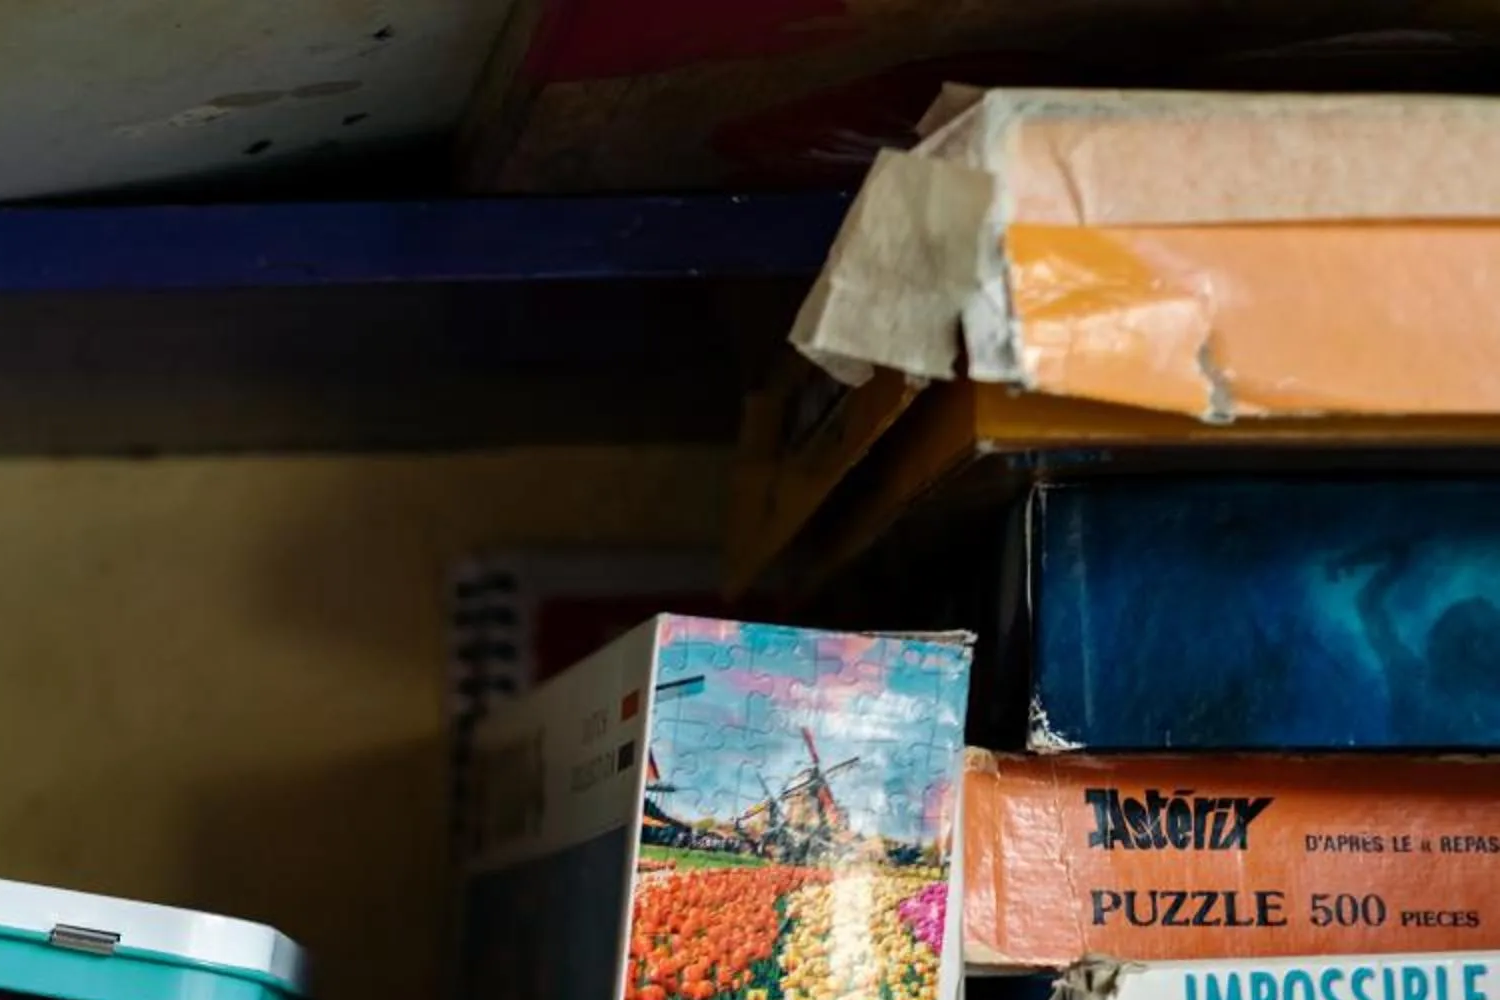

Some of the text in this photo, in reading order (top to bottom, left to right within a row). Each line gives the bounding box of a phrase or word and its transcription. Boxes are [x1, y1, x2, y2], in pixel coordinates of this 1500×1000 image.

[1393, 835, 1412, 853] LE
[1440, 835, 1500, 853] REPAS
[1091, 891, 1481, 928] PUZZLE 500 PIECES
